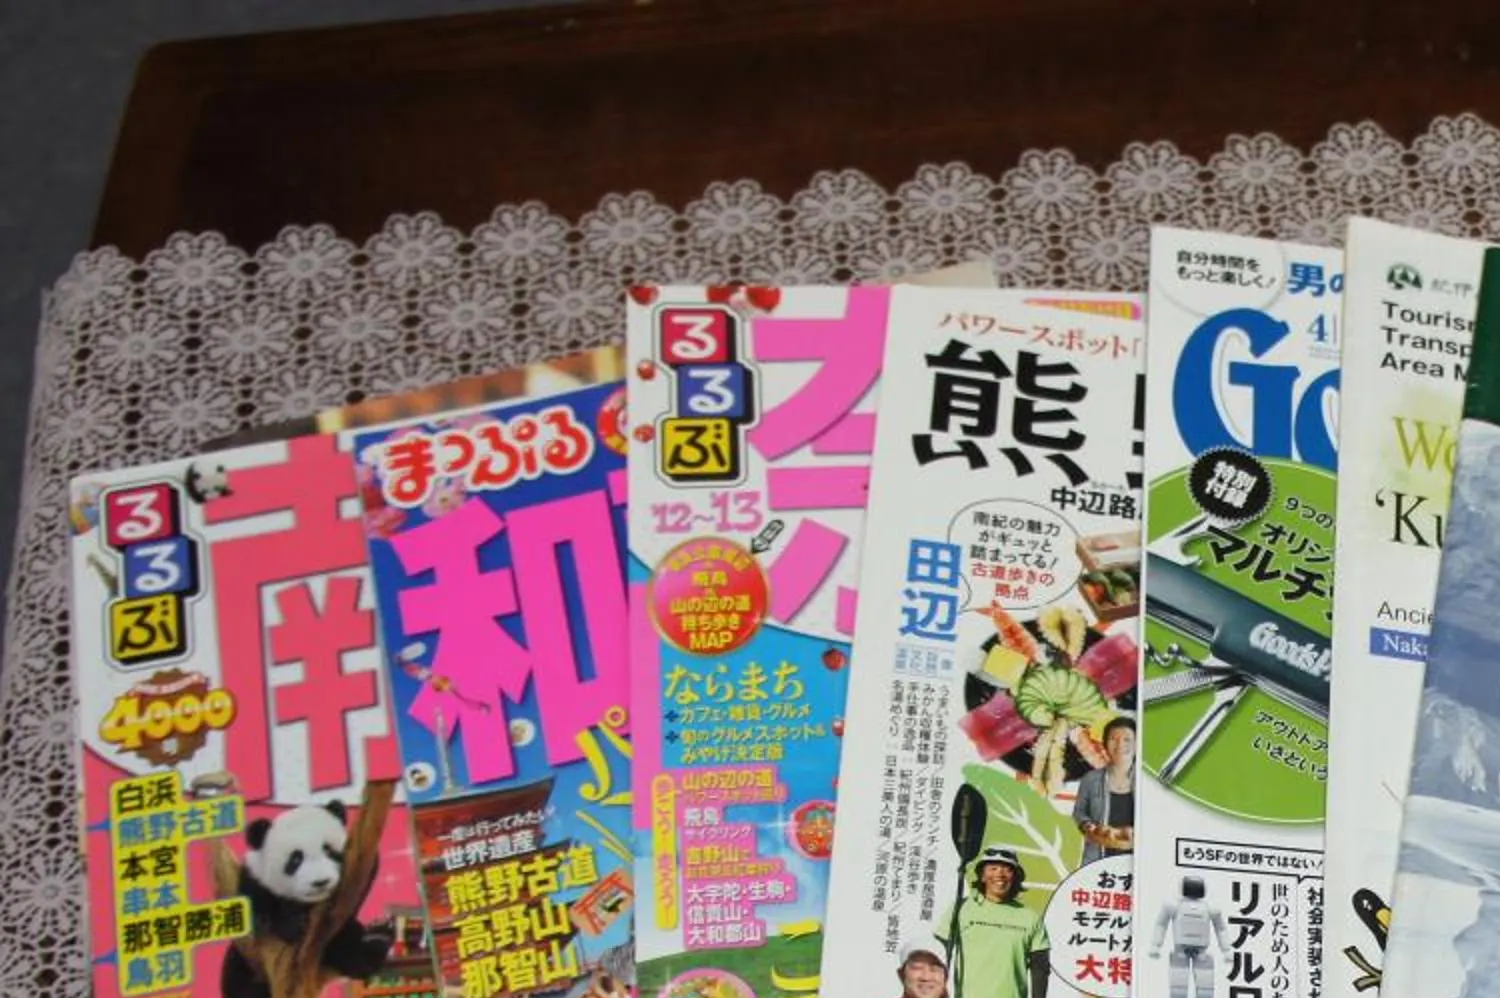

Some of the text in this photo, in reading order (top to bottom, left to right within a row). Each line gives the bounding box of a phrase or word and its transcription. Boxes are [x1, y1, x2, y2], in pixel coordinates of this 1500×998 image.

[1177, 250, 1261, 273] 自分時間を
[1307, 314, 1329, 343] 4
[1379, 351, 1445, 378] Area
[667, 314, 736, 471] るるぶ
[385, 406, 590, 505] まっぷる
[1213, 460, 1258, 491] 特別
[973, 510, 1062, 537] 南紀の魅力
[978, 530, 1054, 553] がギュッと
[115, 489, 180, 653] るるぶ
[971, 561, 1055, 587] 古道歩きの
[1207, 524, 1333, 601] マルチ
[897, 537, 962, 643] 田辺
[994, 581, 1031, 602] 拠点
[389, 489, 630, 784] 和
[689, 631, 734, 650] MAP
[664, 660, 806, 706] ならまち
[100, 688, 234, 750] 4000
[117, 779, 177, 812] 白浜
[682, 768, 776, 789] 山の辺の道
[117, 801, 239, 847] 熊野古道
[120, 845, 179, 881] 本宮
[444, 829, 537, 871] 世界遺産
[446, 844, 599, 915] 熊野古道
[122, 882, 180, 916] 串本
[1072, 888, 1132, 912] 中辺路
[123, 903, 246, 955] 那智勝浦
[453, 896, 572, 959] 高野山
[687, 924, 762, 945] 大和郡山
[1072, 911, 1134, 930] モデル
[126, 950, 186, 991] 鳥羽
[1075, 954, 1132, 985] 大特
